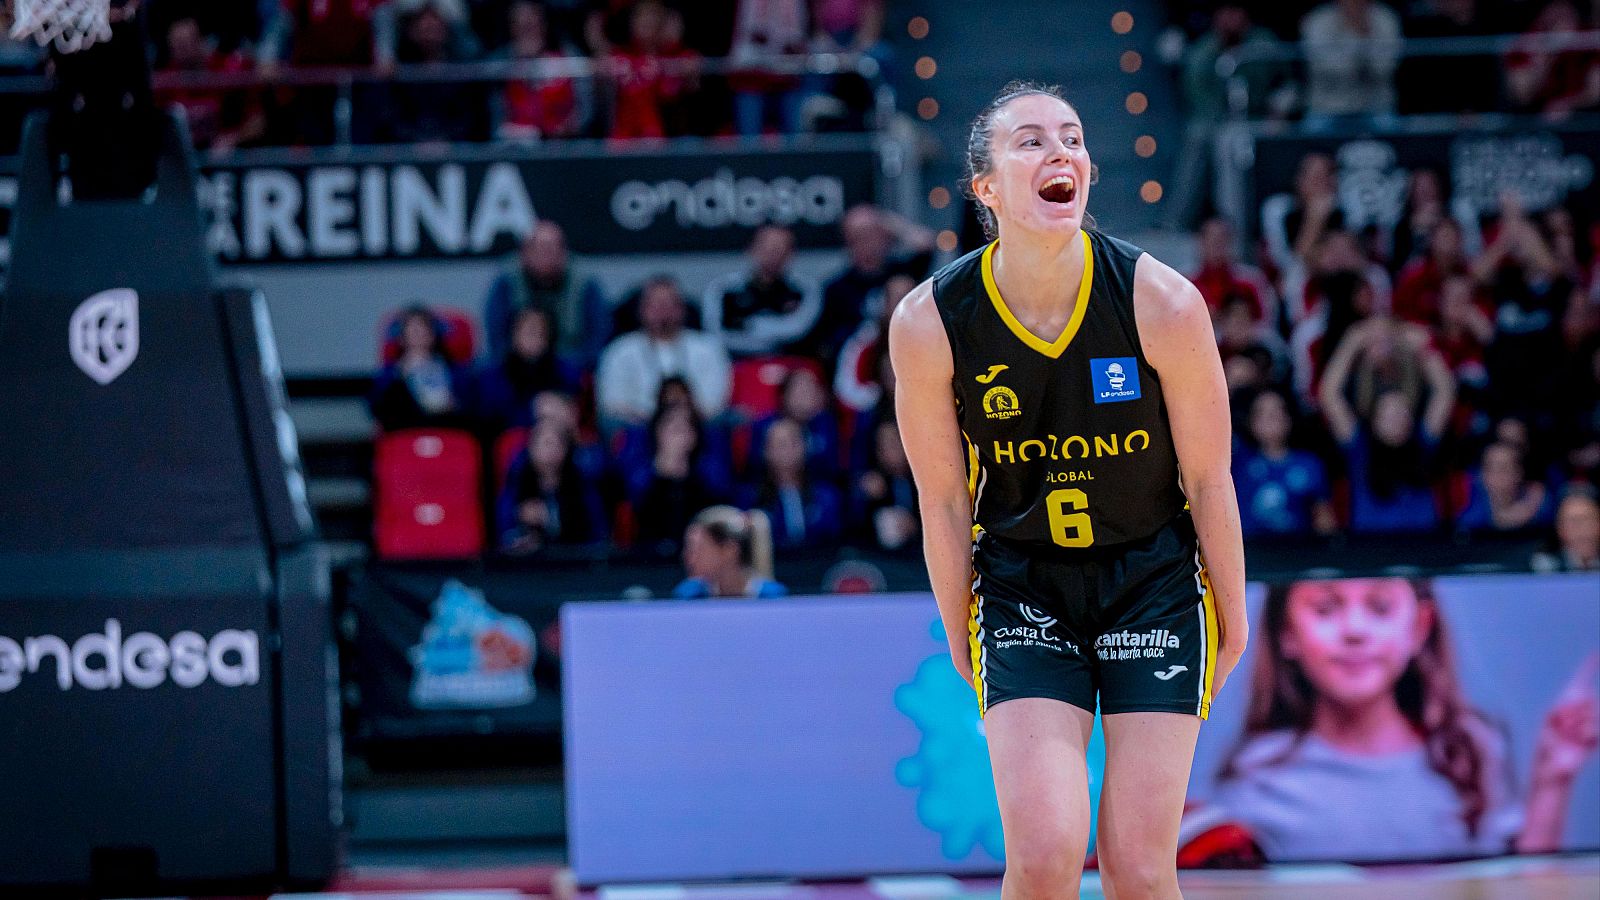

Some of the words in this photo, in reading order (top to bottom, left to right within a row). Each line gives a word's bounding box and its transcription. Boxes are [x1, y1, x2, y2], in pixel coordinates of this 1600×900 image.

[244, 163, 537, 258] REINA
[610, 166, 844, 231] endesa
[1045, 488, 1094, 548] 6
[1023, 638, 1034, 646] de
[1110, 647, 1117, 660] la
[1143, 647, 1165, 658] nace
